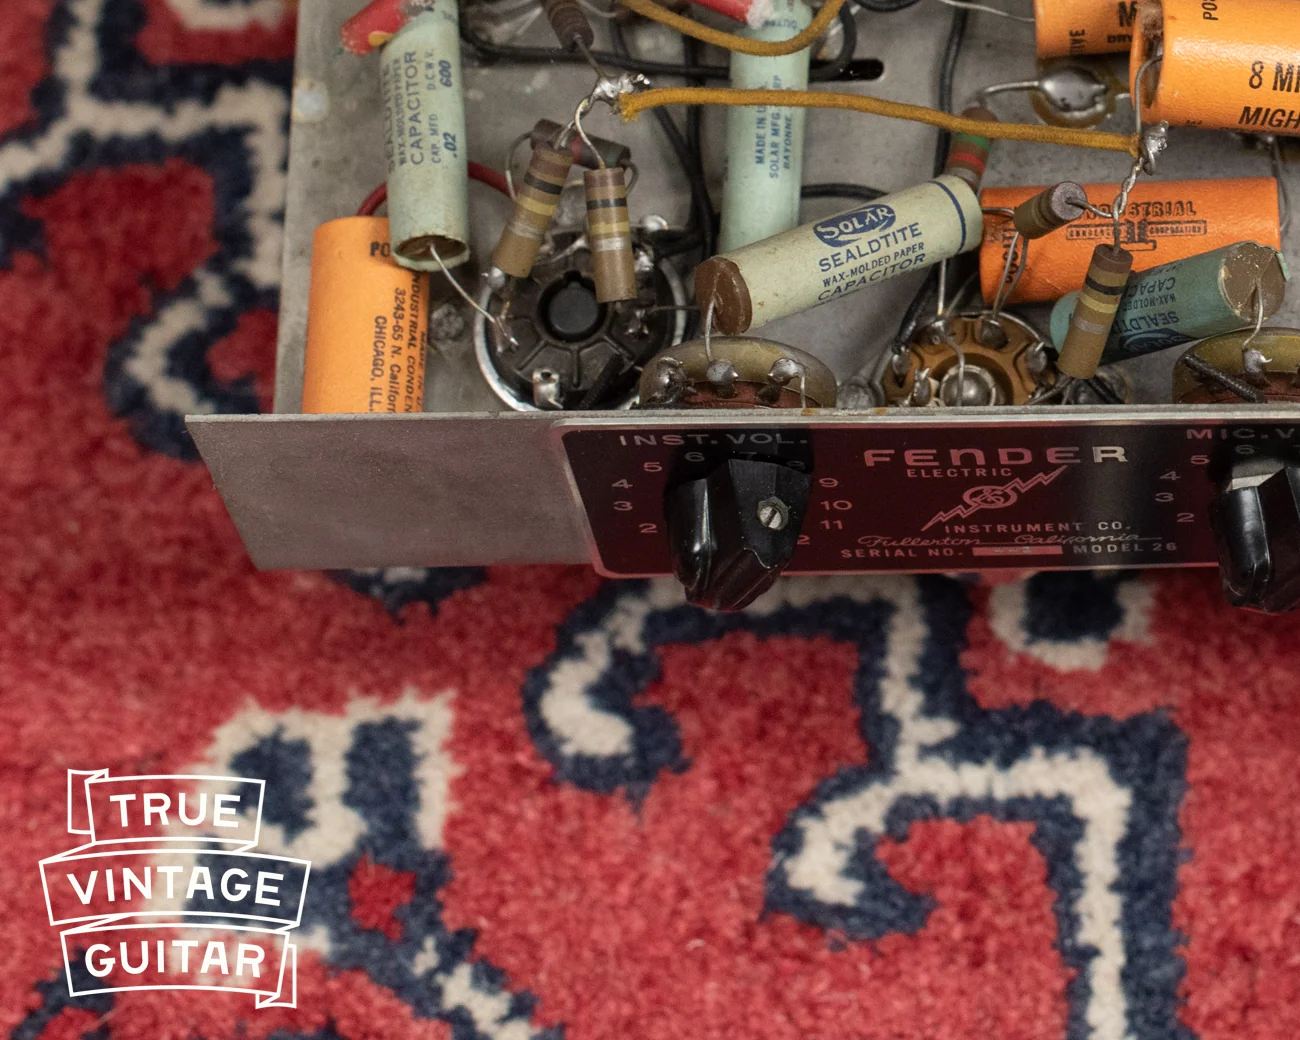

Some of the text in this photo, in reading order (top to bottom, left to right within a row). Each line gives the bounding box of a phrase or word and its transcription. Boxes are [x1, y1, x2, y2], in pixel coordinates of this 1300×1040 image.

[1248, 60, 1265, 90] 8
[404, 50, 425, 166] CAPACITOR
[437, 59, 459, 159] .02 600
[756, 117, 767, 131] IN
[755, 133, 766, 166] MADE
[769, 142, 781, 179] SOLAR
[816, 207, 896, 240] SOLAR
[818, 222, 923, 273] SEALDTITE
[822, 254, 893, 288] WAX-MOLDED
[893, 241, 925, 262] PAPER
[817, 252, 927, 302] CAPACITOR
[392, 287, 406, 341] 3243-65
[407, 272, 422, 350] NDUSTRIAL
[370, 315, 387, 382] CHICAGO,
[685, 451, 706, 462] 6
[862, 445, 1130, 468] FENDER
[1234, 445, 1255, 455] 6
[1190, 454, 1211, 465] 5
[643, 462, 663, 473] 5
[906, 467, 1014, 479] ELECTRIC
[818, 477, 840, 488] 9
[1159, 471, 1181, 481] 4
[611, 478, 633, 489] 4
[1154, 492, 1175, 503] 3
[613, 501, 633, 511] 3
[820, 500, 853, 511] 10
[1176, 512, 1196, 523] 2
[638, 523, 659, 534] 2
[820, 519, 845, 531] 11
[944, 520, 1132, 534] INSTRUMENT CO.
[840, 542, 1178, 559] SERIAL NO. MODEL 26
